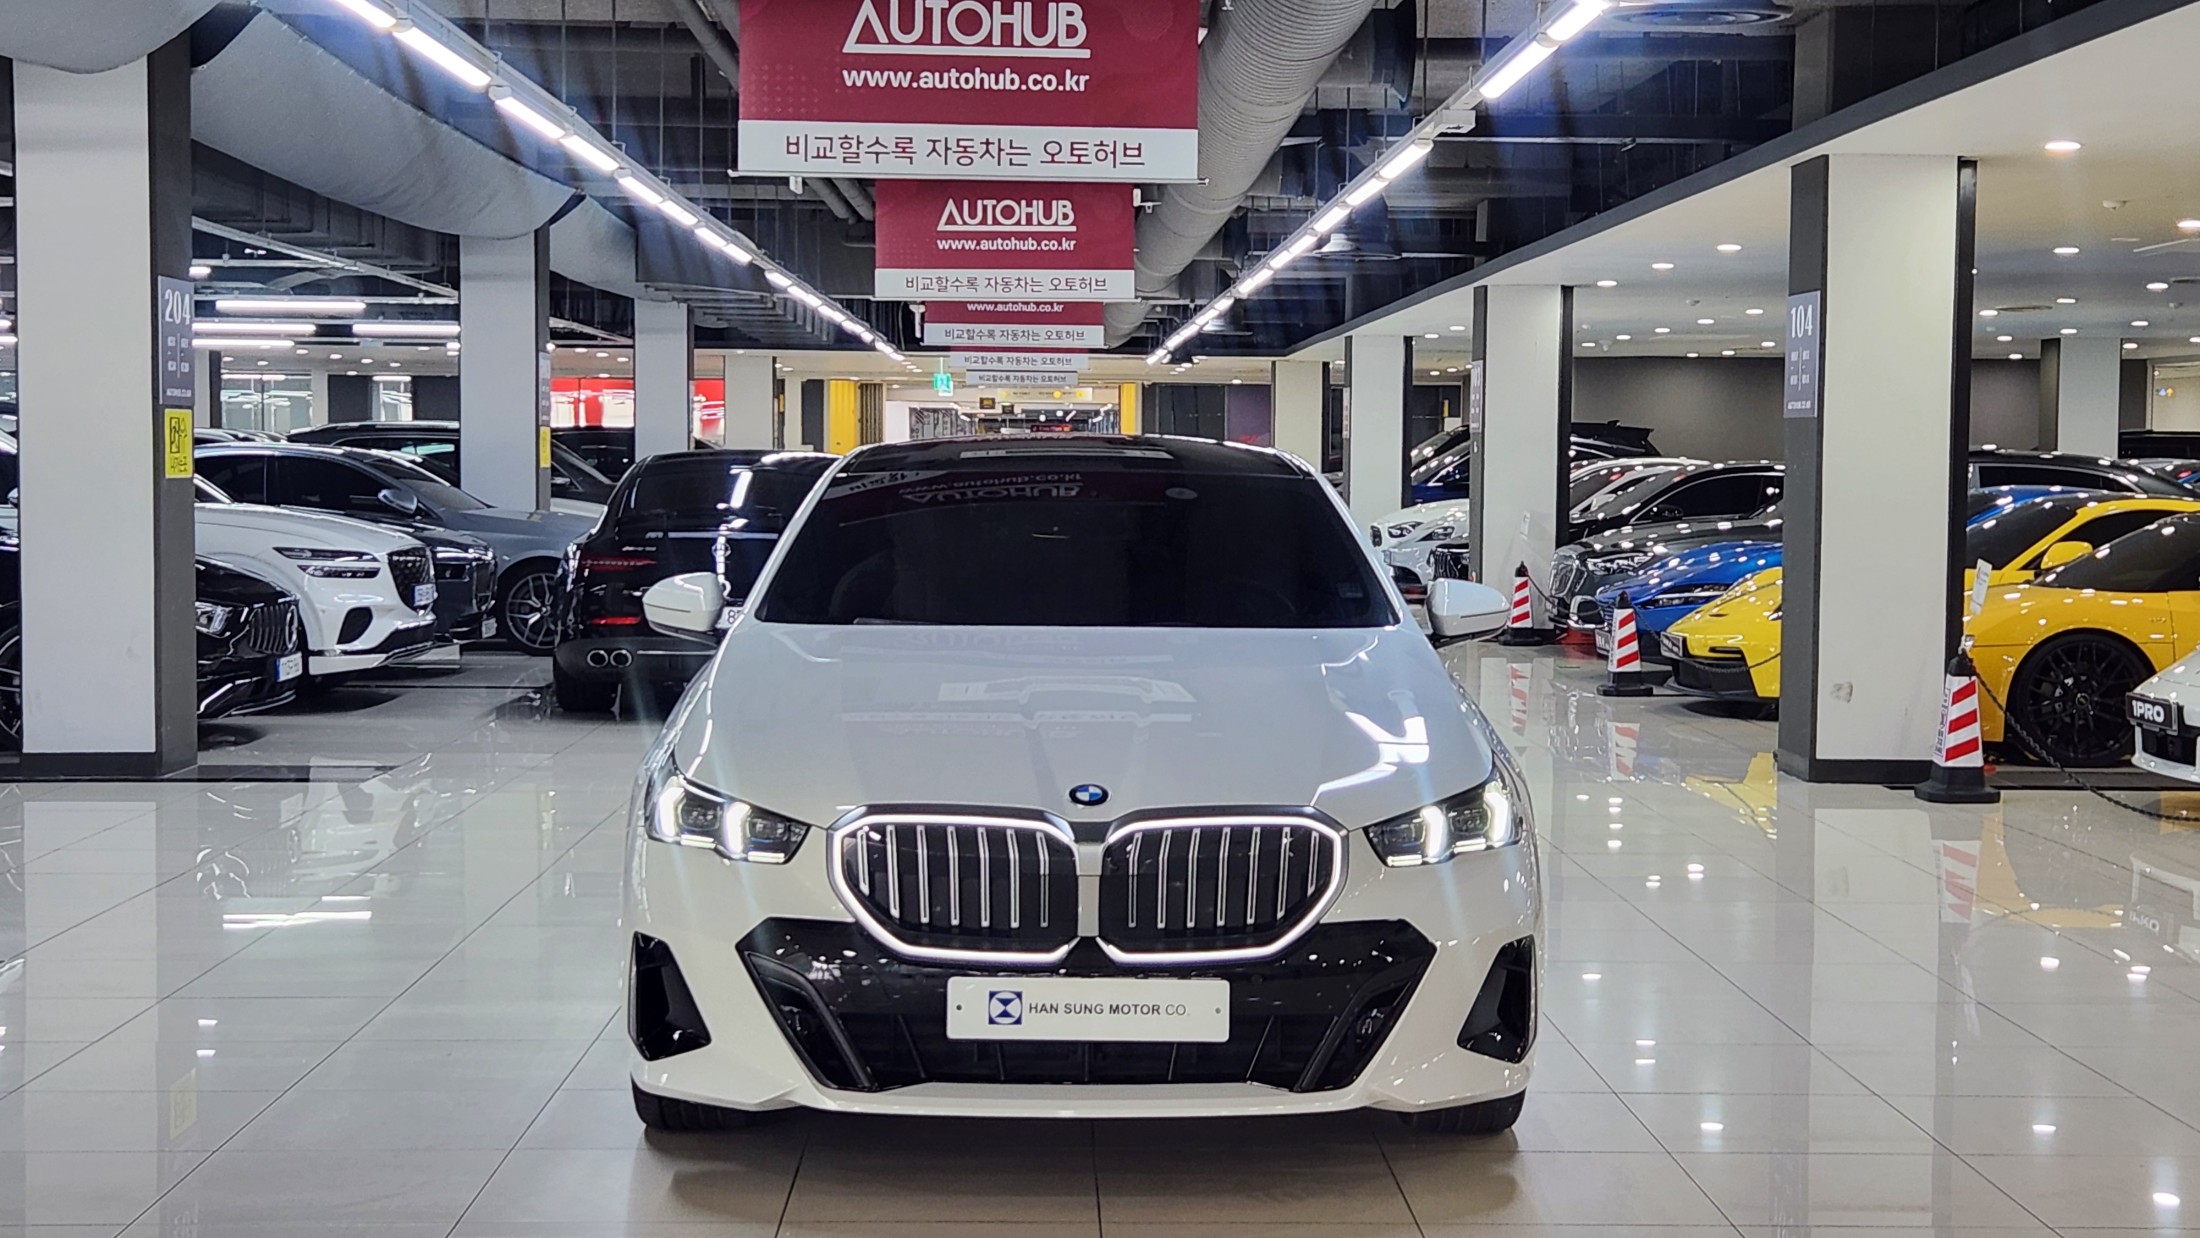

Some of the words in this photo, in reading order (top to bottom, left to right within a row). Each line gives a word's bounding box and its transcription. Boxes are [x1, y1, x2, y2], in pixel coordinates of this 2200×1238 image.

[842, 0, 1091, 58] AUTOHUB
[842, 66, 1090, 92] www.autohub.co.kr
[786, 134, 917, 166] 비교할수록
[925, 136, 1032, 168] 자동차는
[1039, 139, 1146, 168] 오토허브
[936, 198, 1077, 232] AUTOHUB
[936, 236, 1077, 251] www.autohub.co.kr
[905, 276, 980, 292] 비교할수록
[984, 276, 1044, 293] 자동차는
[1048, 277, 1109, 293] 오토허브
[164, 288, 191, 325] 204
[966, 302, 1064, 313] www.autohub.co.kr
[1790, 304, 1813, 338] 104
[944, 329, 996, 340] 비교할수록
[999, 330, 1041, 341] 자동차는
[1044, 330, 1086, 342] 오토허브
[964, 356, 1004, 365] 비교할수록
[1006, 357, 1038, 366] 자동차는
[1040, 357, 1072, 366] 오토허브
[978, 374, 1011, 383] 비교할수록
[1012, 375, 1039, 383] 자동차는
[1041, 375, 1067, 384] 오토허브
[2131, 699, 2165, 723] 1PRO
[1029, 1003, 1059, 1015] HAN
[1064, 1003, 1104, 1015] SUNG
[1108, 1004, 1161, 1016] MOTOR
